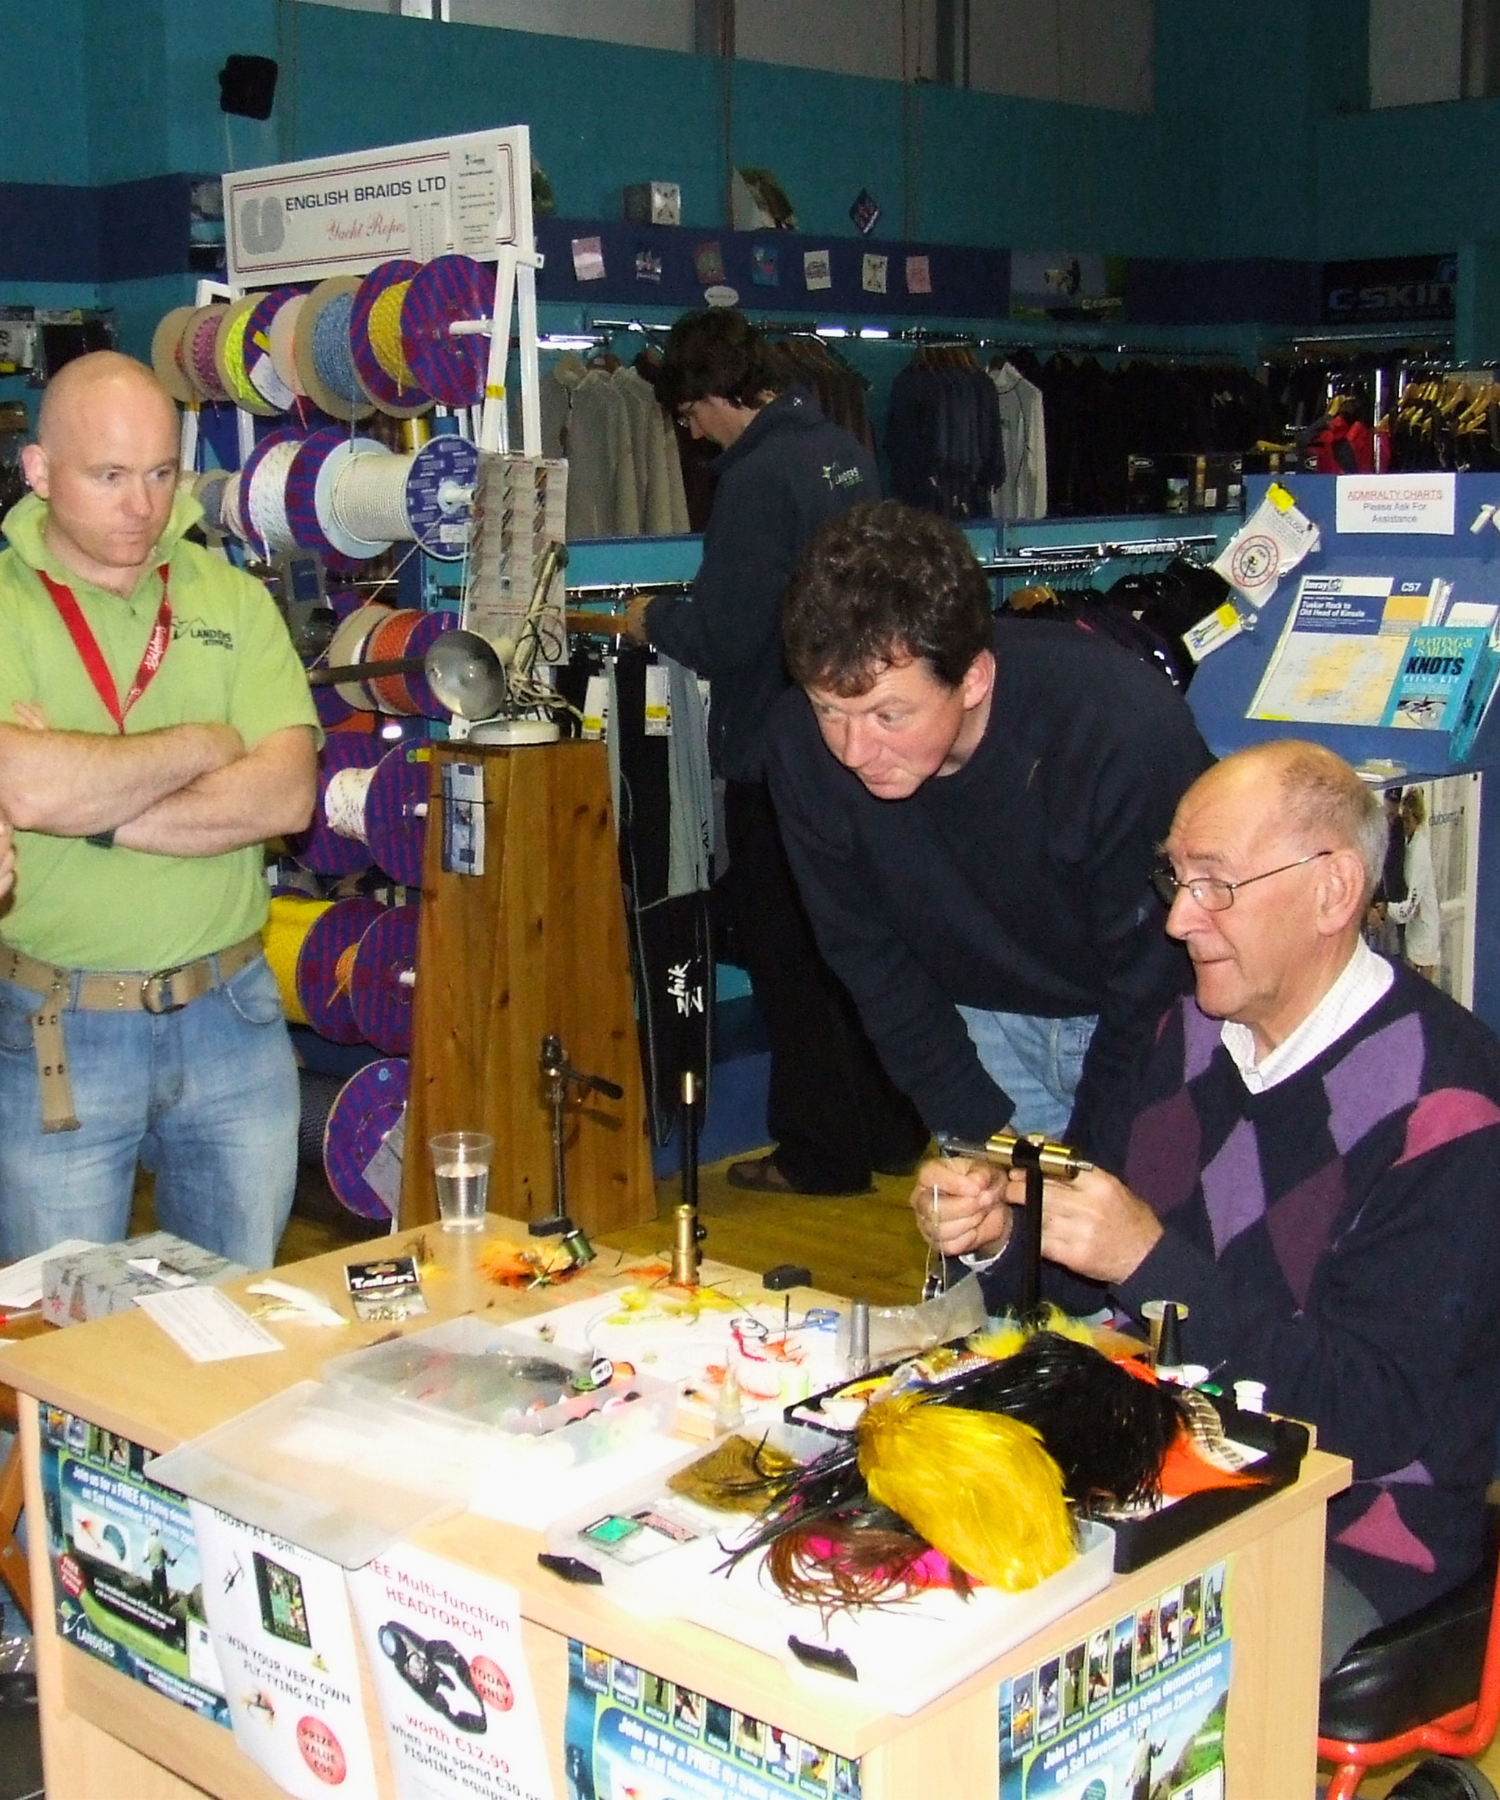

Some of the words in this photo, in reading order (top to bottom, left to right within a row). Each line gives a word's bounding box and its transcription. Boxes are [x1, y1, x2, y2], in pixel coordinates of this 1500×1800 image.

[286, 190, 349, 211] ENGLISH
[355, 181, 411, 202] BRAIDS
[418, 176, 447, 193] LTD
[327, 218, 364, 241] Yacht
[366, 212, 406, 243] Ropes
[1348, 490, 1400, 500] ADMIRALTY
[1403, 489, 1443, 500] CHARTS
[1363, 502, 1392, 511] Please
[1394, 502, 1410, 511] Ask
[1412, 502, 1427, 511] For
[1372, 514, 1418, 523] Assistance
[1401, 582, 1422, 592] C57
[1300, 608, 1312, 616] Old
[1312, 608, 1331, 617] Head
[191, 629, 232, 643] LANDERS
[1405, 656, 1465, 675] KNOTS
[351, 1274, 415, 1290] Talon
[386, 1585, 484, 1642] HEADTORCH
[398, 1571, 511, 1633] Multi-function
[77, 1626, 115, 1658] LANDERS
[243, 1659, 302, 1700] FLY-TYING
[305, 1692, 327, 1711] KIT
[252, 1646, 281, 1670] YOUR
[285, 1665, 316, 1688] VERY
[320, 1683, 352, 1705] OWN
[471, 1665, 511, 1691] TODAY
[478, 1683, 510, 1705] ONLY
[1100, 1702, 1127, 1735] FREE
[301, 1727, 334, 1748] PRIZE
[405, 1713, 450, 1745] worth
[455, 1736, 511, 1775] €12.99
[305, 1742, 337, 1764] VALUE
[390, 1721, 423, 1747] when
[426, 1742, 449, 1761] you
[452, 1756, 492, 1783] spend
[404, 1743, 458, 1781] FISHING
